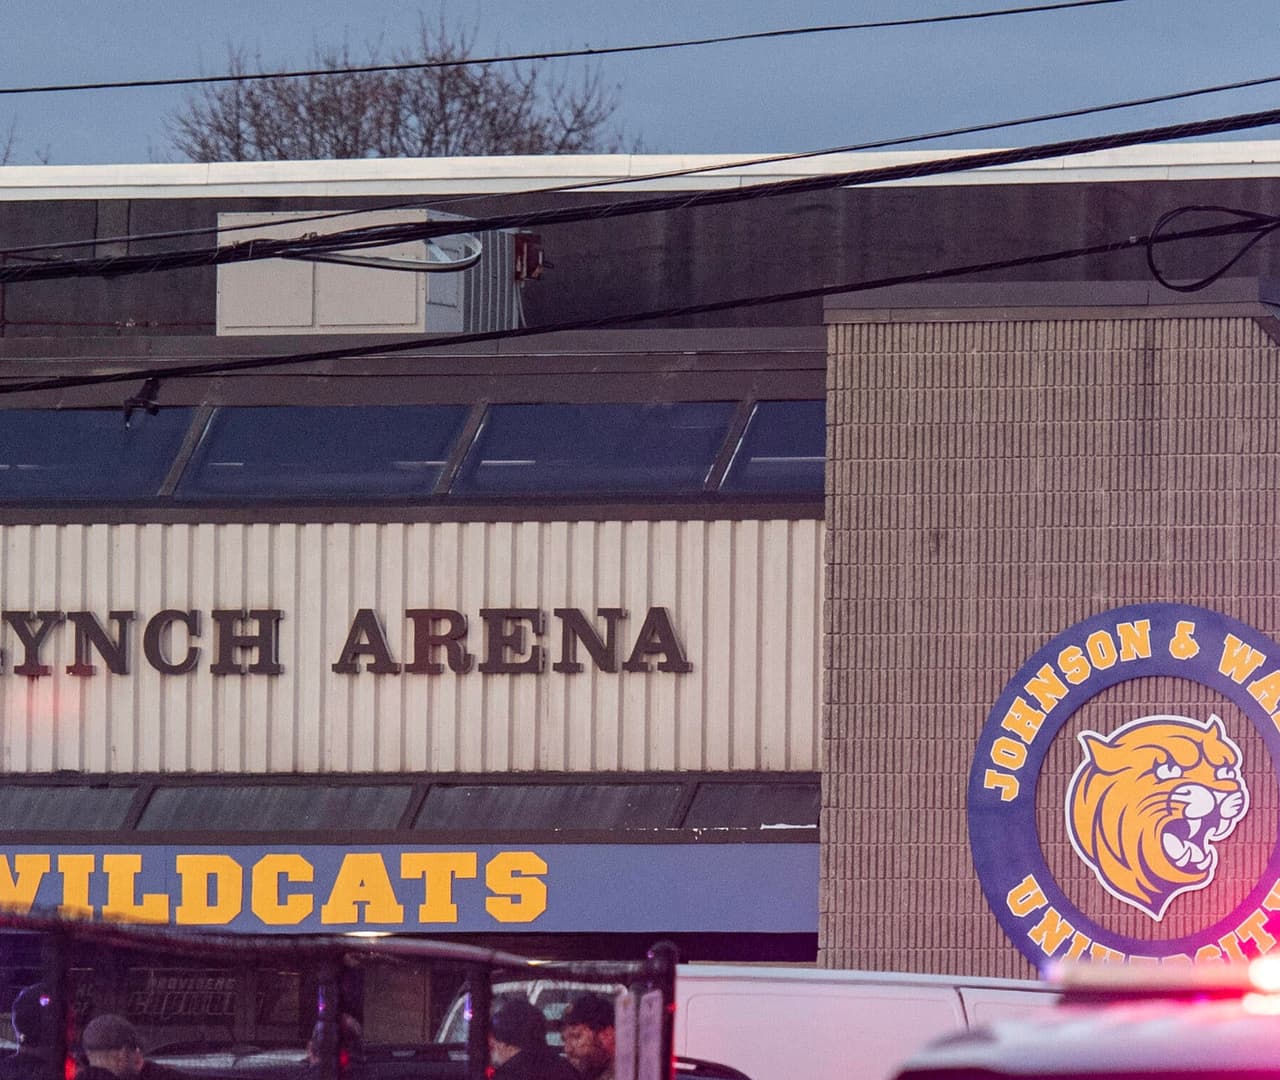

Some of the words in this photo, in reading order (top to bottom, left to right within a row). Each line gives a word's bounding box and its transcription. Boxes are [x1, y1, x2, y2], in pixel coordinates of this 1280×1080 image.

[331, 607, 693, 674] ARENA
[983, 619, 1152, 802] JOHNSON
[1168, 620, 1200, 661] &
